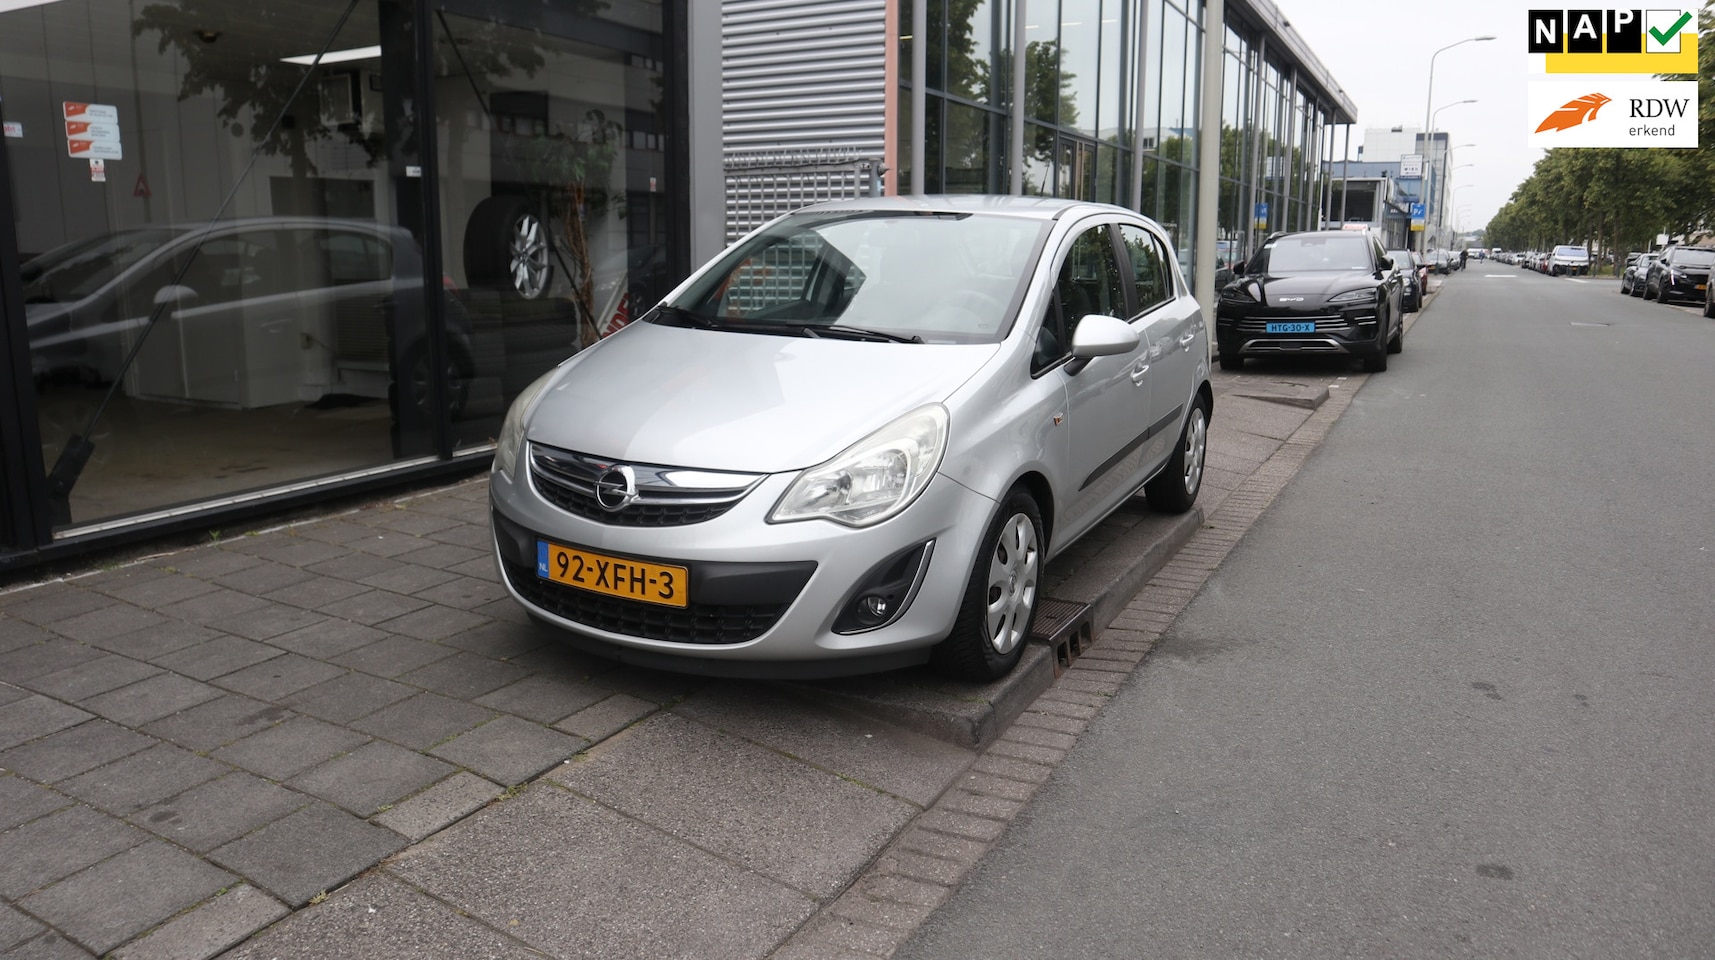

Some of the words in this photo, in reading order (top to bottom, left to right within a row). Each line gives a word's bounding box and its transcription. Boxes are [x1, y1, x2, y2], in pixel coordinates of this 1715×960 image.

[1271, 324, 1310, 332] HTG-30-X
[539, 562, 548, 573] NL
[556, 551, 674, 600] 92-XFH-3
